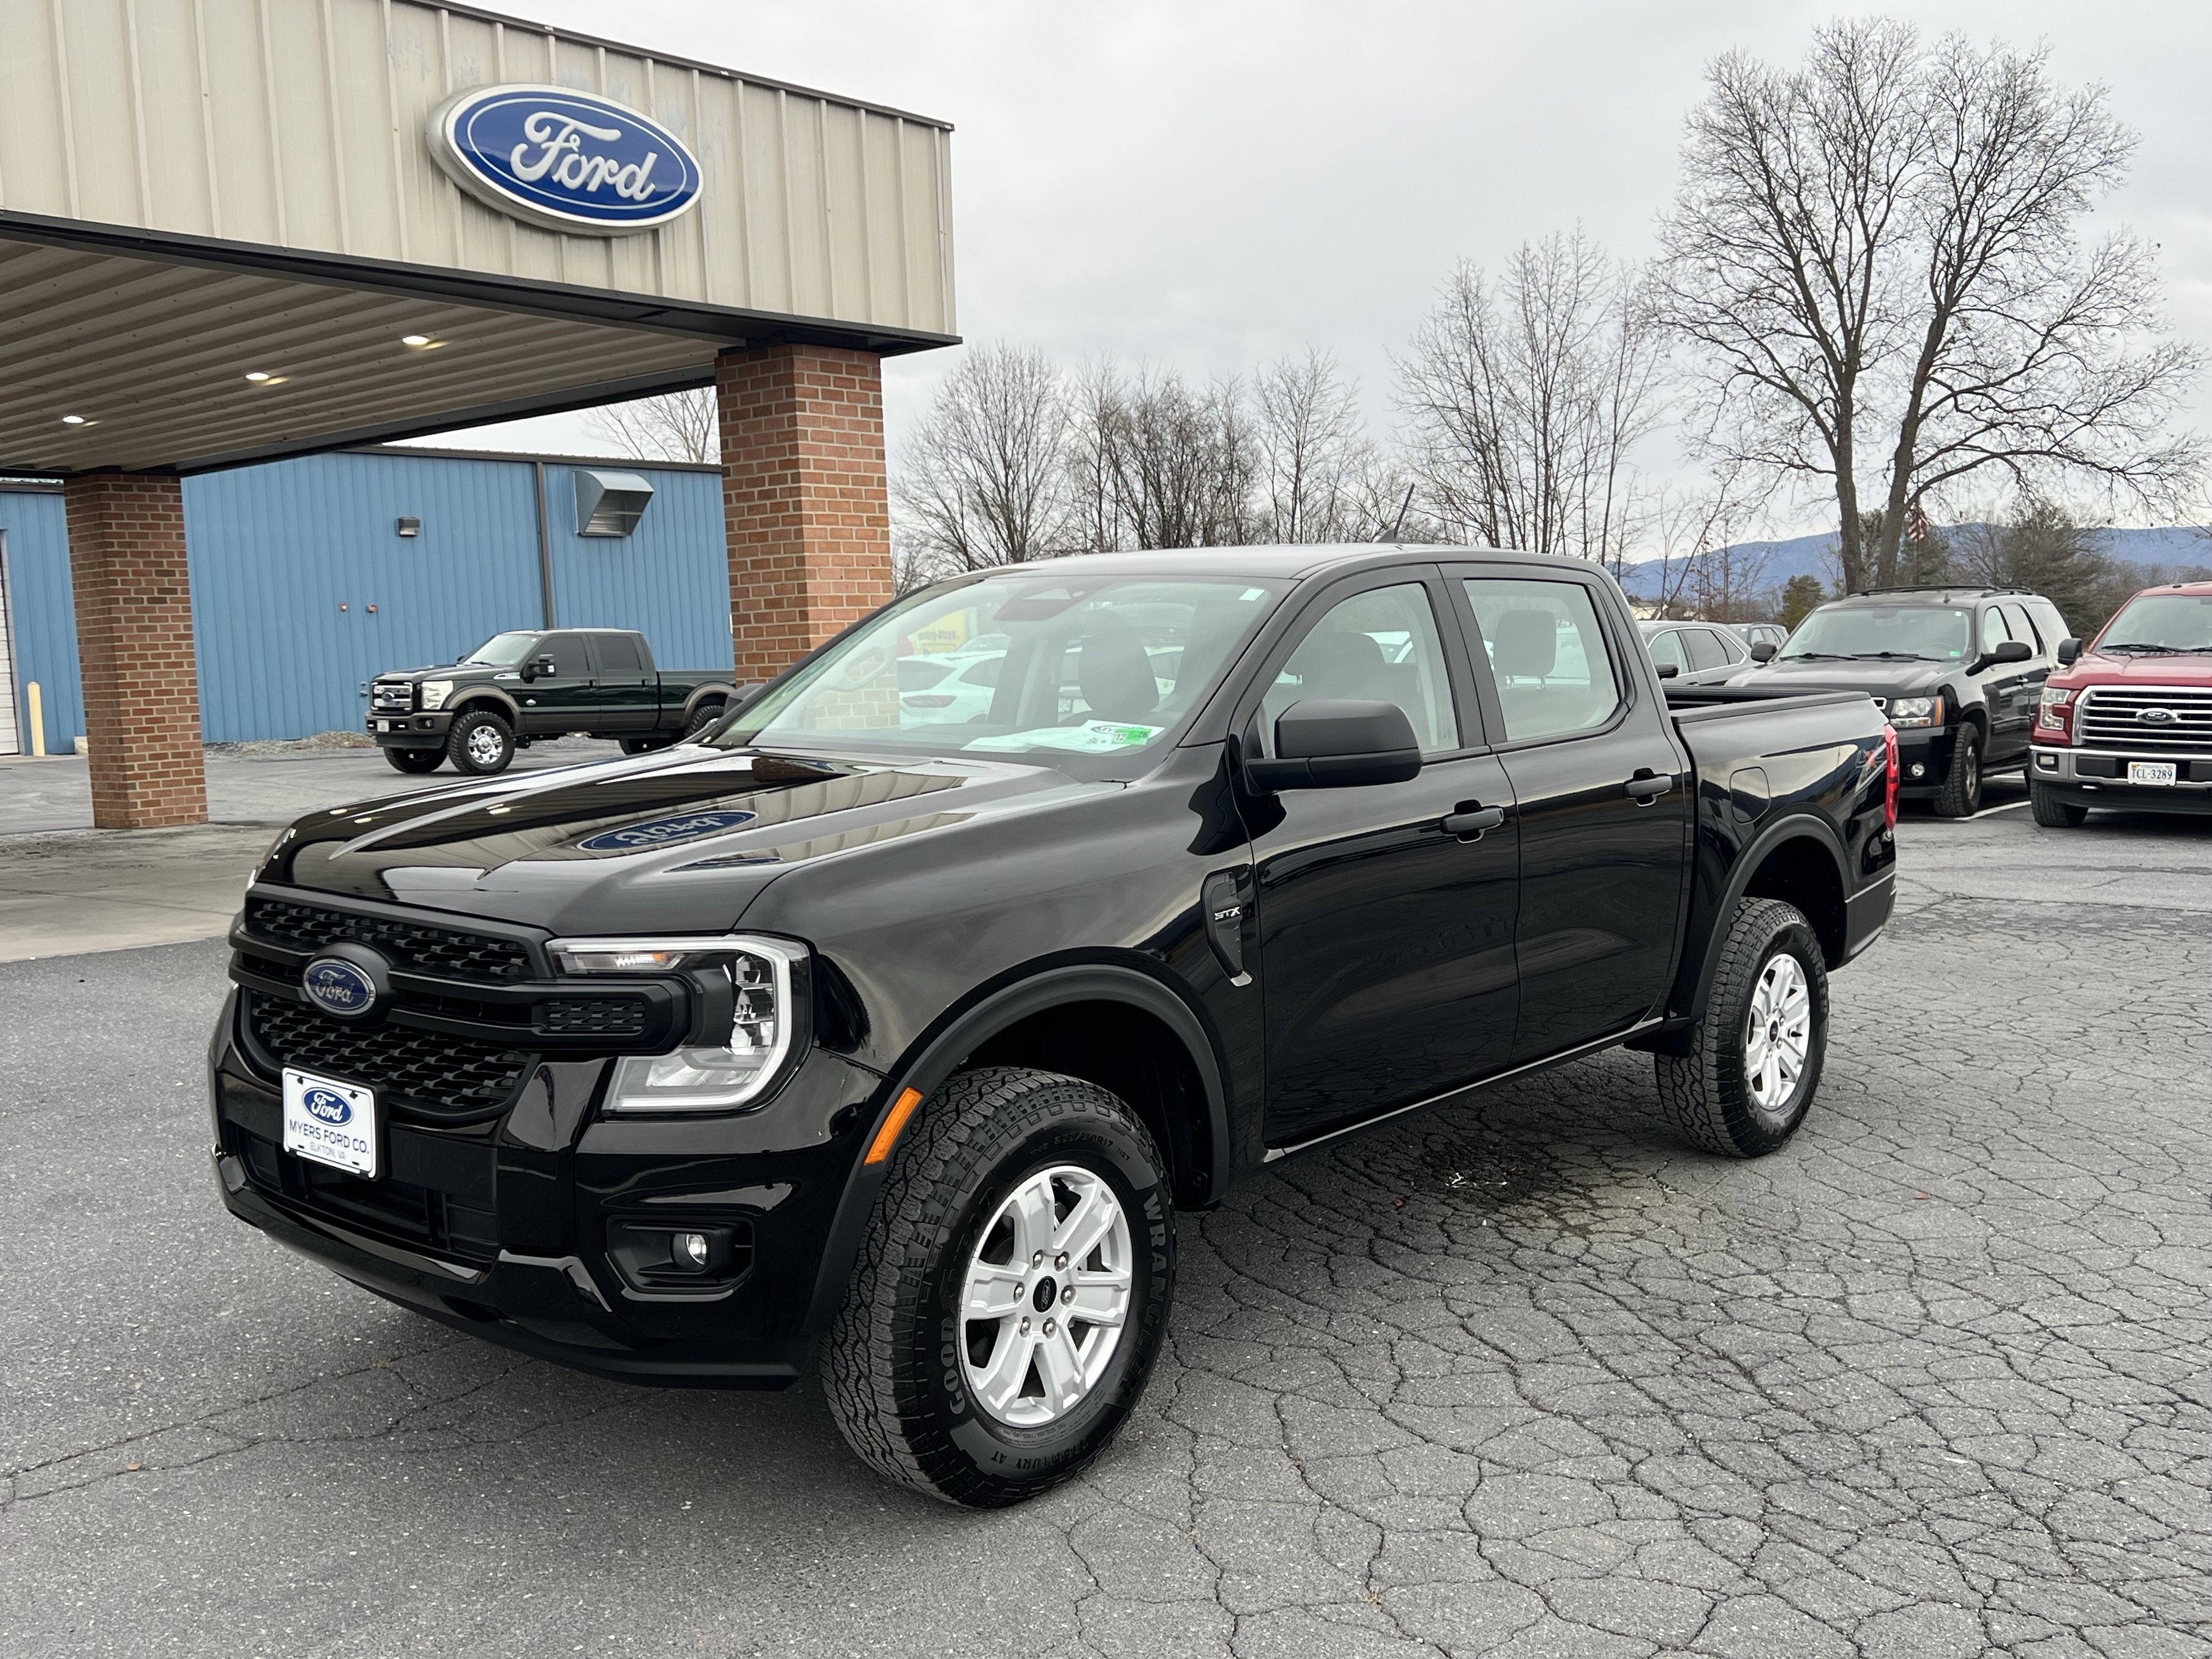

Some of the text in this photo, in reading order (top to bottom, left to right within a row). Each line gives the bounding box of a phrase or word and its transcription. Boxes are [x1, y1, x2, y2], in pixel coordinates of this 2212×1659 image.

[510, 111, 658, 201] Ford
[1214, 906, 1240, 921] STX
[315, 969, 356, 1003] Ford
[311, 1092, 343, 1121] Ford
[290, 1119, 370, 1154] MYERS FORD CO.
[991, 1451, 1007, 1464] AT
